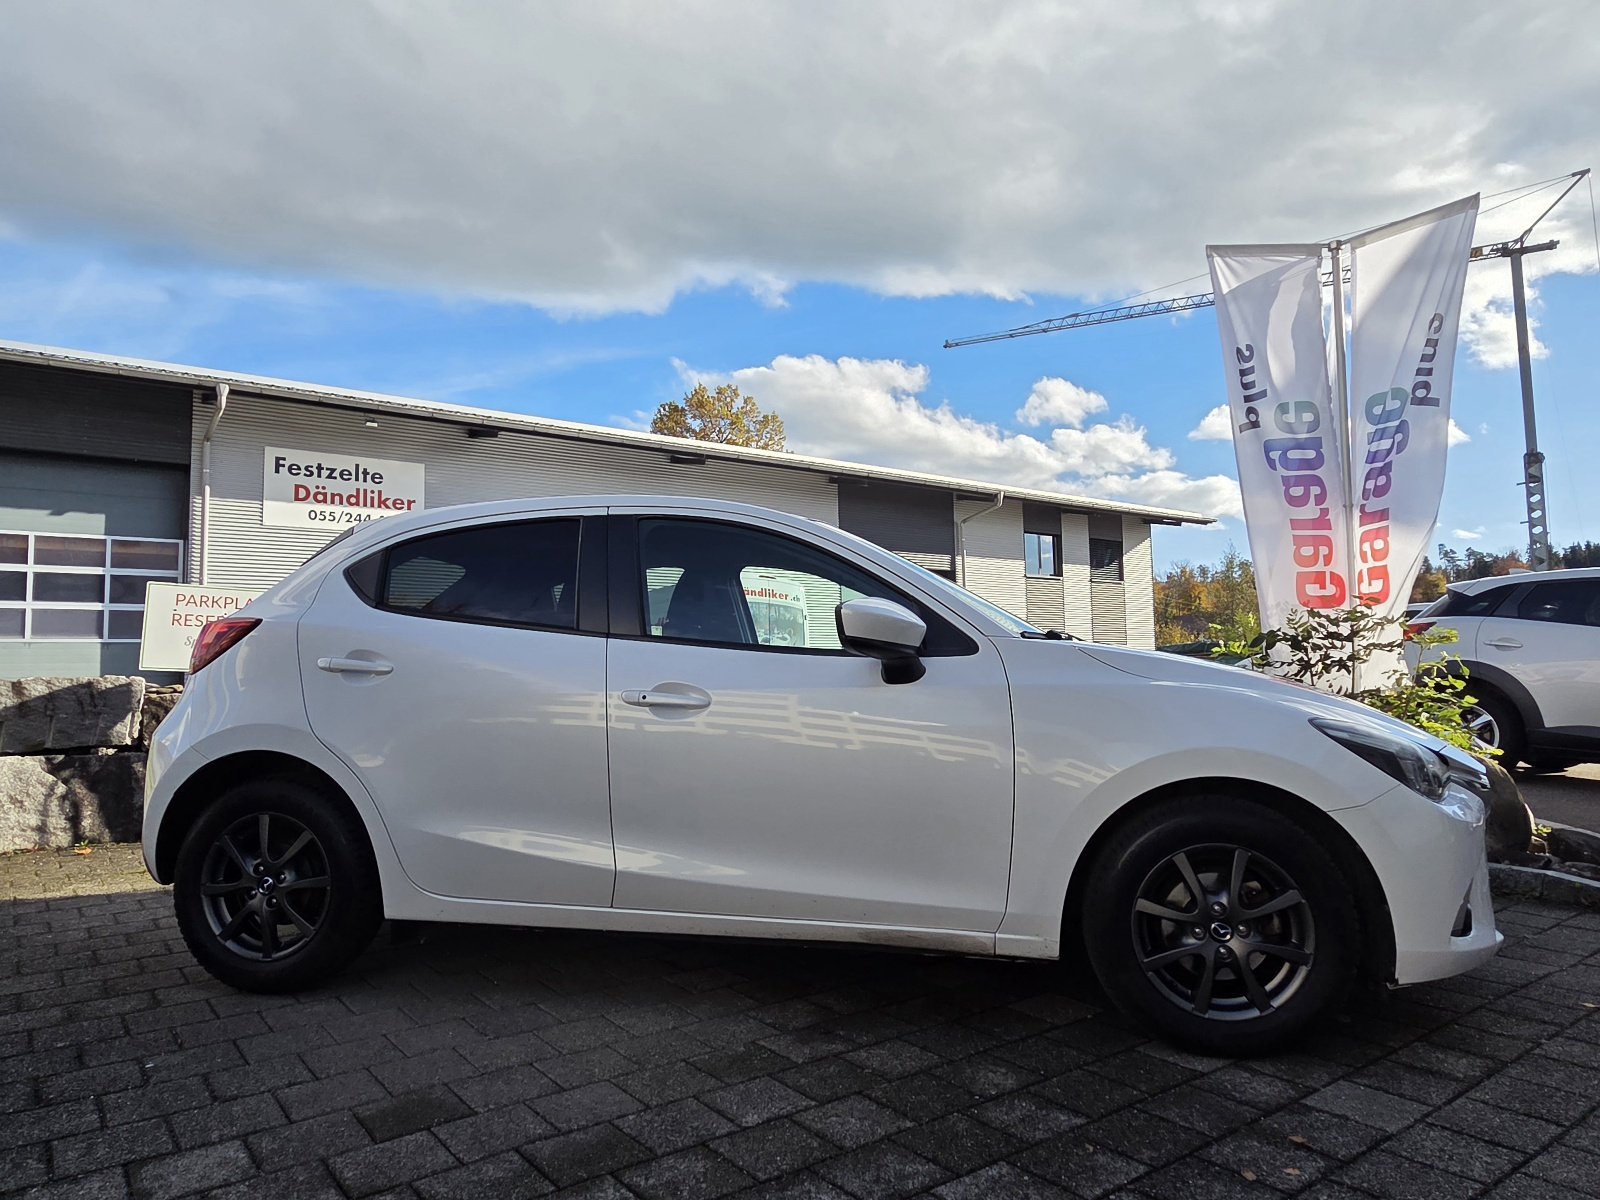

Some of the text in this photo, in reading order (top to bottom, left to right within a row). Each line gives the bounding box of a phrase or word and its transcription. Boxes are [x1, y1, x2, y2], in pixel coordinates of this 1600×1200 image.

[274, 456, 384, 484] Festzelte
[293, 484, 416, 511] Dändliker
[1357, 387, 1410, 606] Garage
